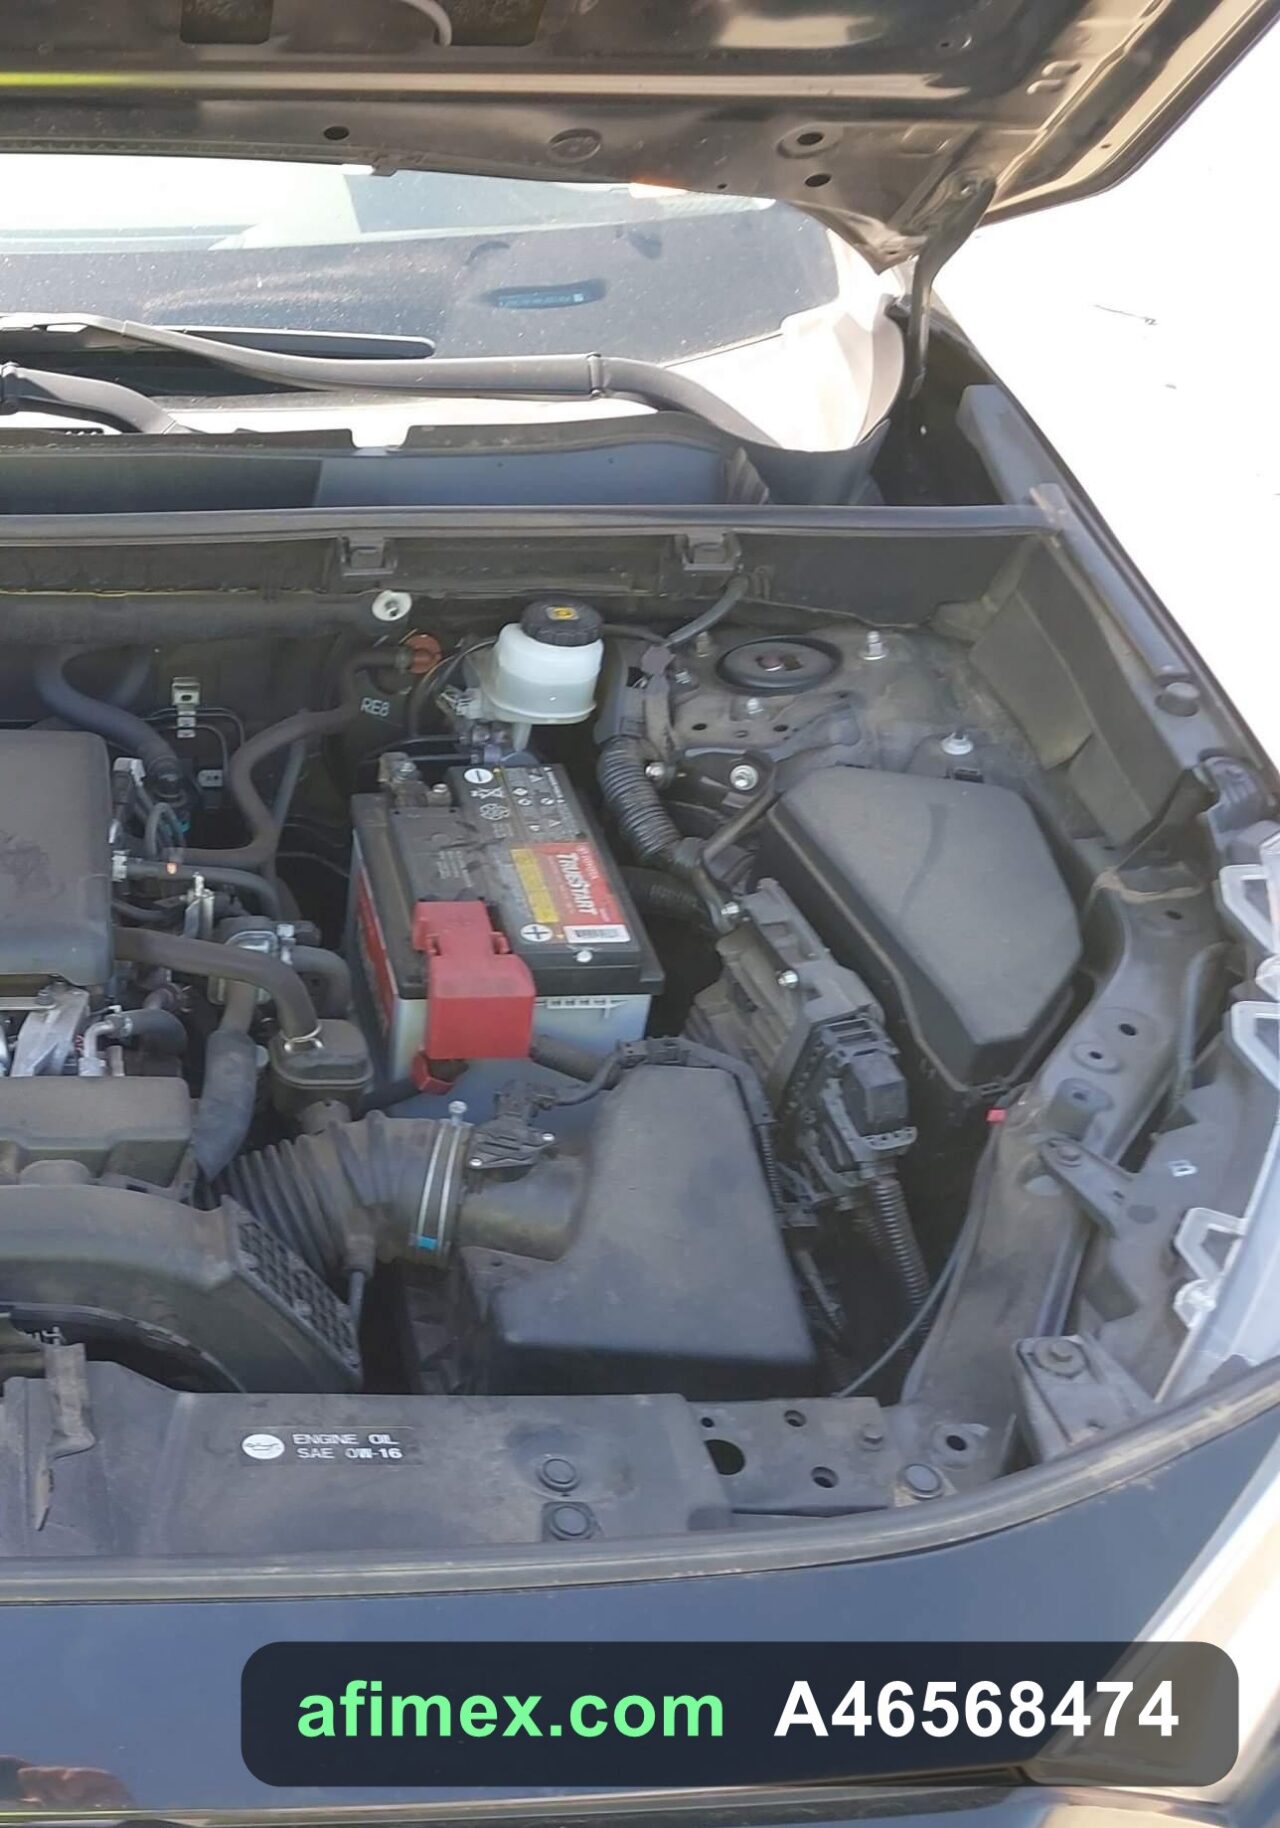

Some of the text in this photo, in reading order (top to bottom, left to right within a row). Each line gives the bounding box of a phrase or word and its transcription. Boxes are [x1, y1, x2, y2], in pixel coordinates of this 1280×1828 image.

[360, 697, 390, 717] RE8
[292, 1433, 400, 1445] ENGINE OIL
[296, 1447, 403, 1459] SAE 0W-16
